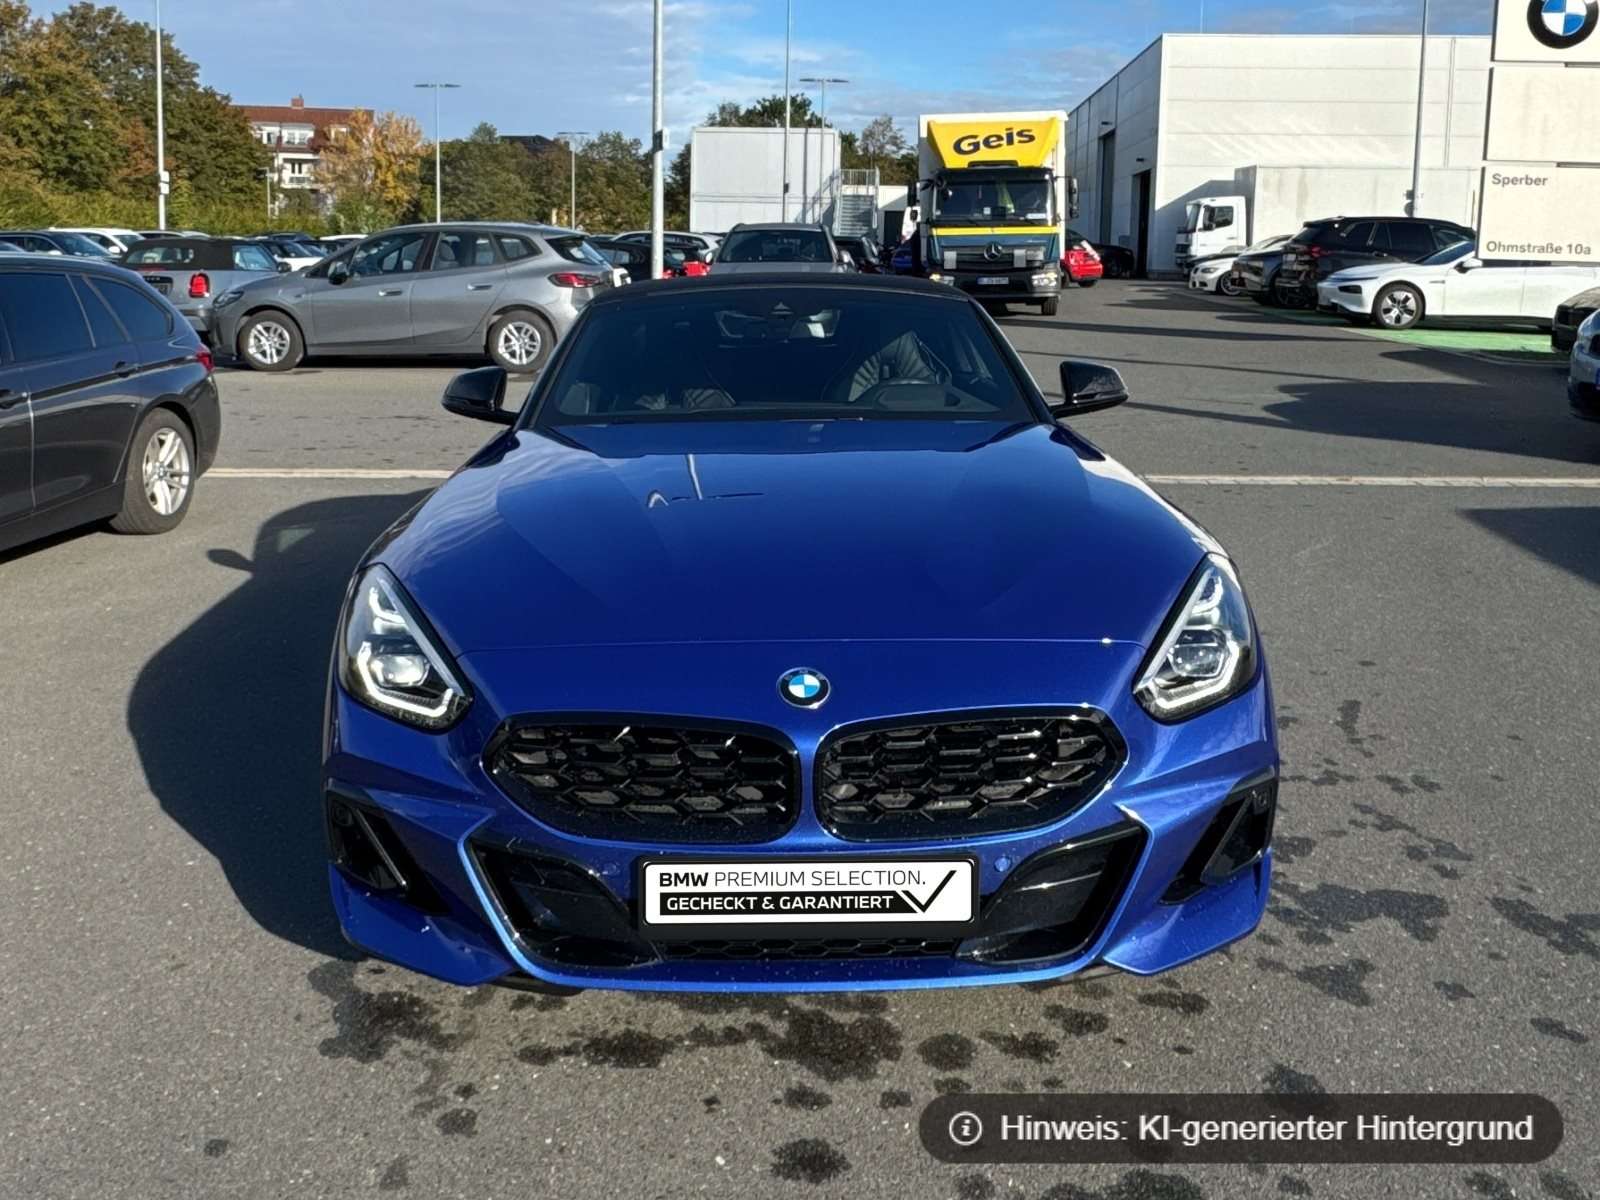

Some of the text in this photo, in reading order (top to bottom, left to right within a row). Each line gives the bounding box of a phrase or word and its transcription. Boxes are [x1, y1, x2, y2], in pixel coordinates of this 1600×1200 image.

[953, 127, 1036, 155] Geis
[1491, 173, 1548, 187] Sperber
[1486, 240, 1592, 255] Ohmstraße 10a
[659, 870, 927, 887] BMW PREMIUM SELECTION.
[666, 895, 894, 911] GECHECKT & GARANTIERT
